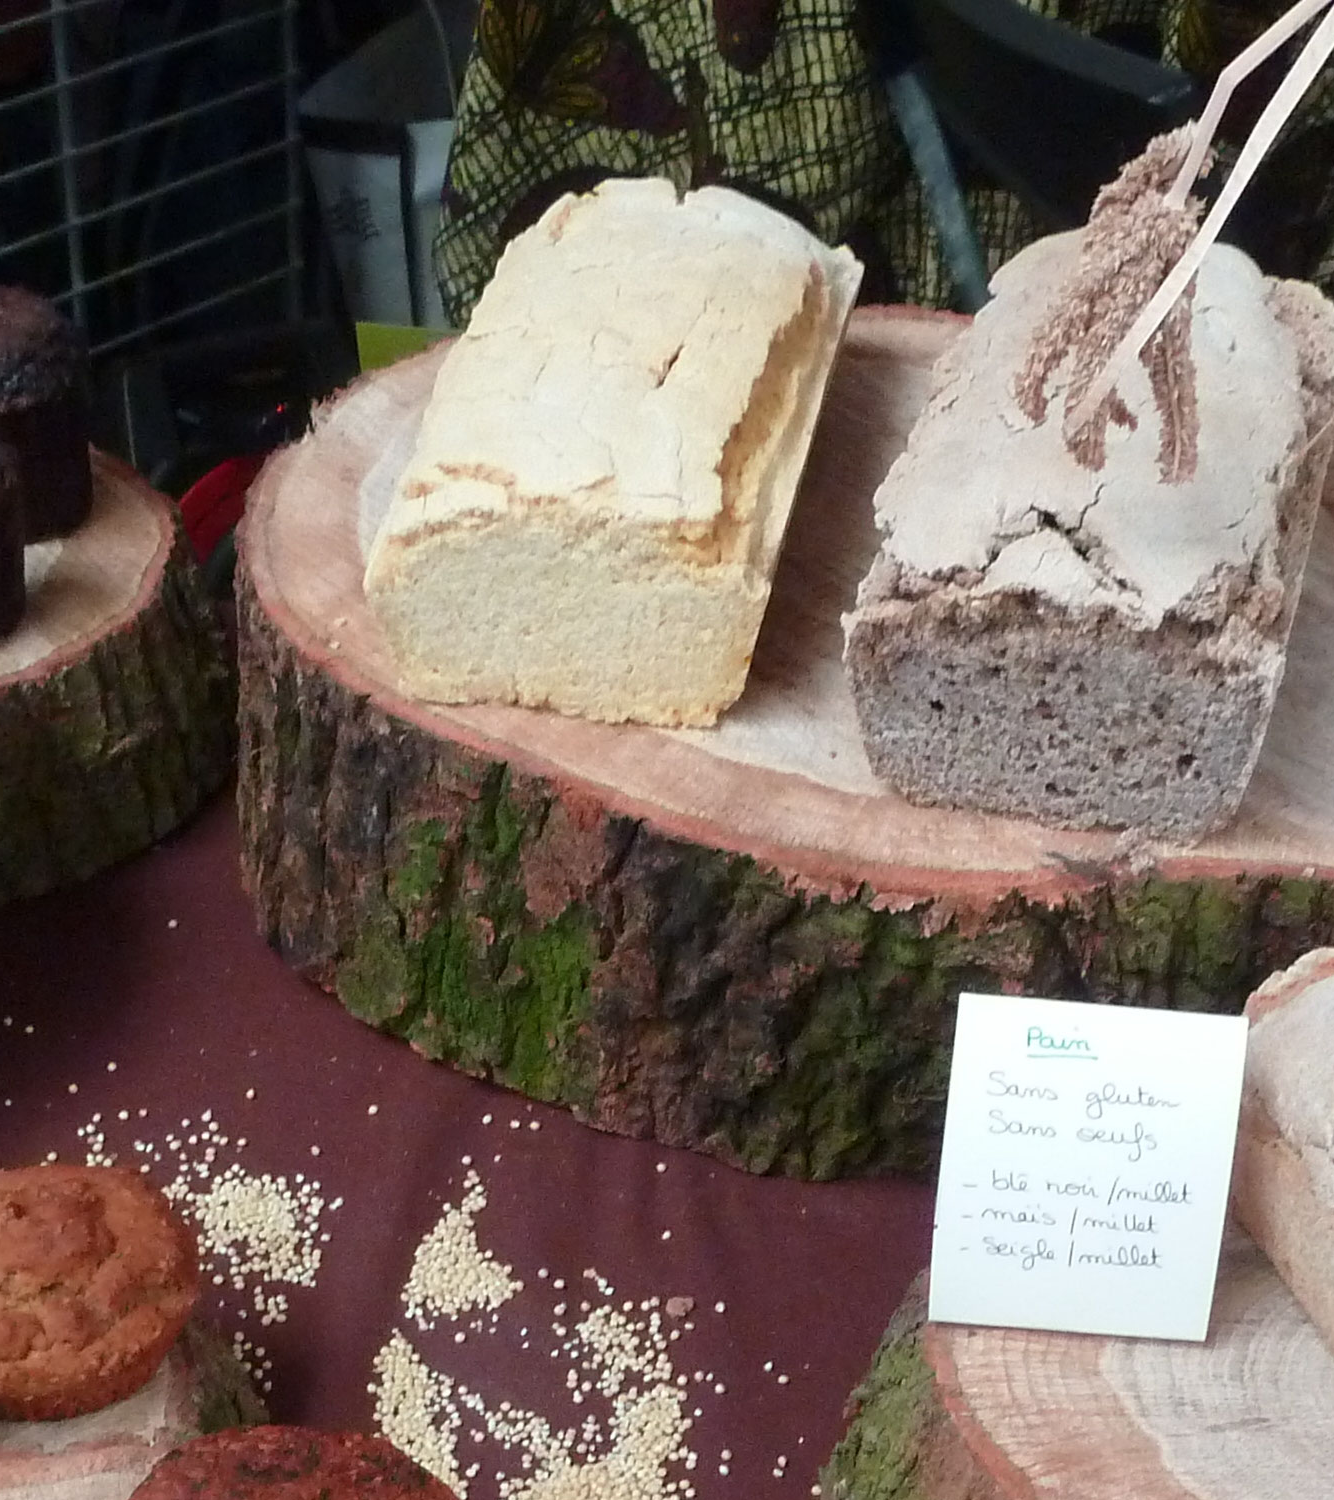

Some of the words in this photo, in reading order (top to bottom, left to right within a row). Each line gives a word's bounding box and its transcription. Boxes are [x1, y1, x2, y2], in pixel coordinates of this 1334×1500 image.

[1026, 1025, 1091, 1052] Pain
[986, 1071, 1058, 1098] Sans
[1085, 1083, 1181, 1119] gluten
[988, 1111, 1057, 1139] Sans
[1046, 1177, 1099, 1199] noir
